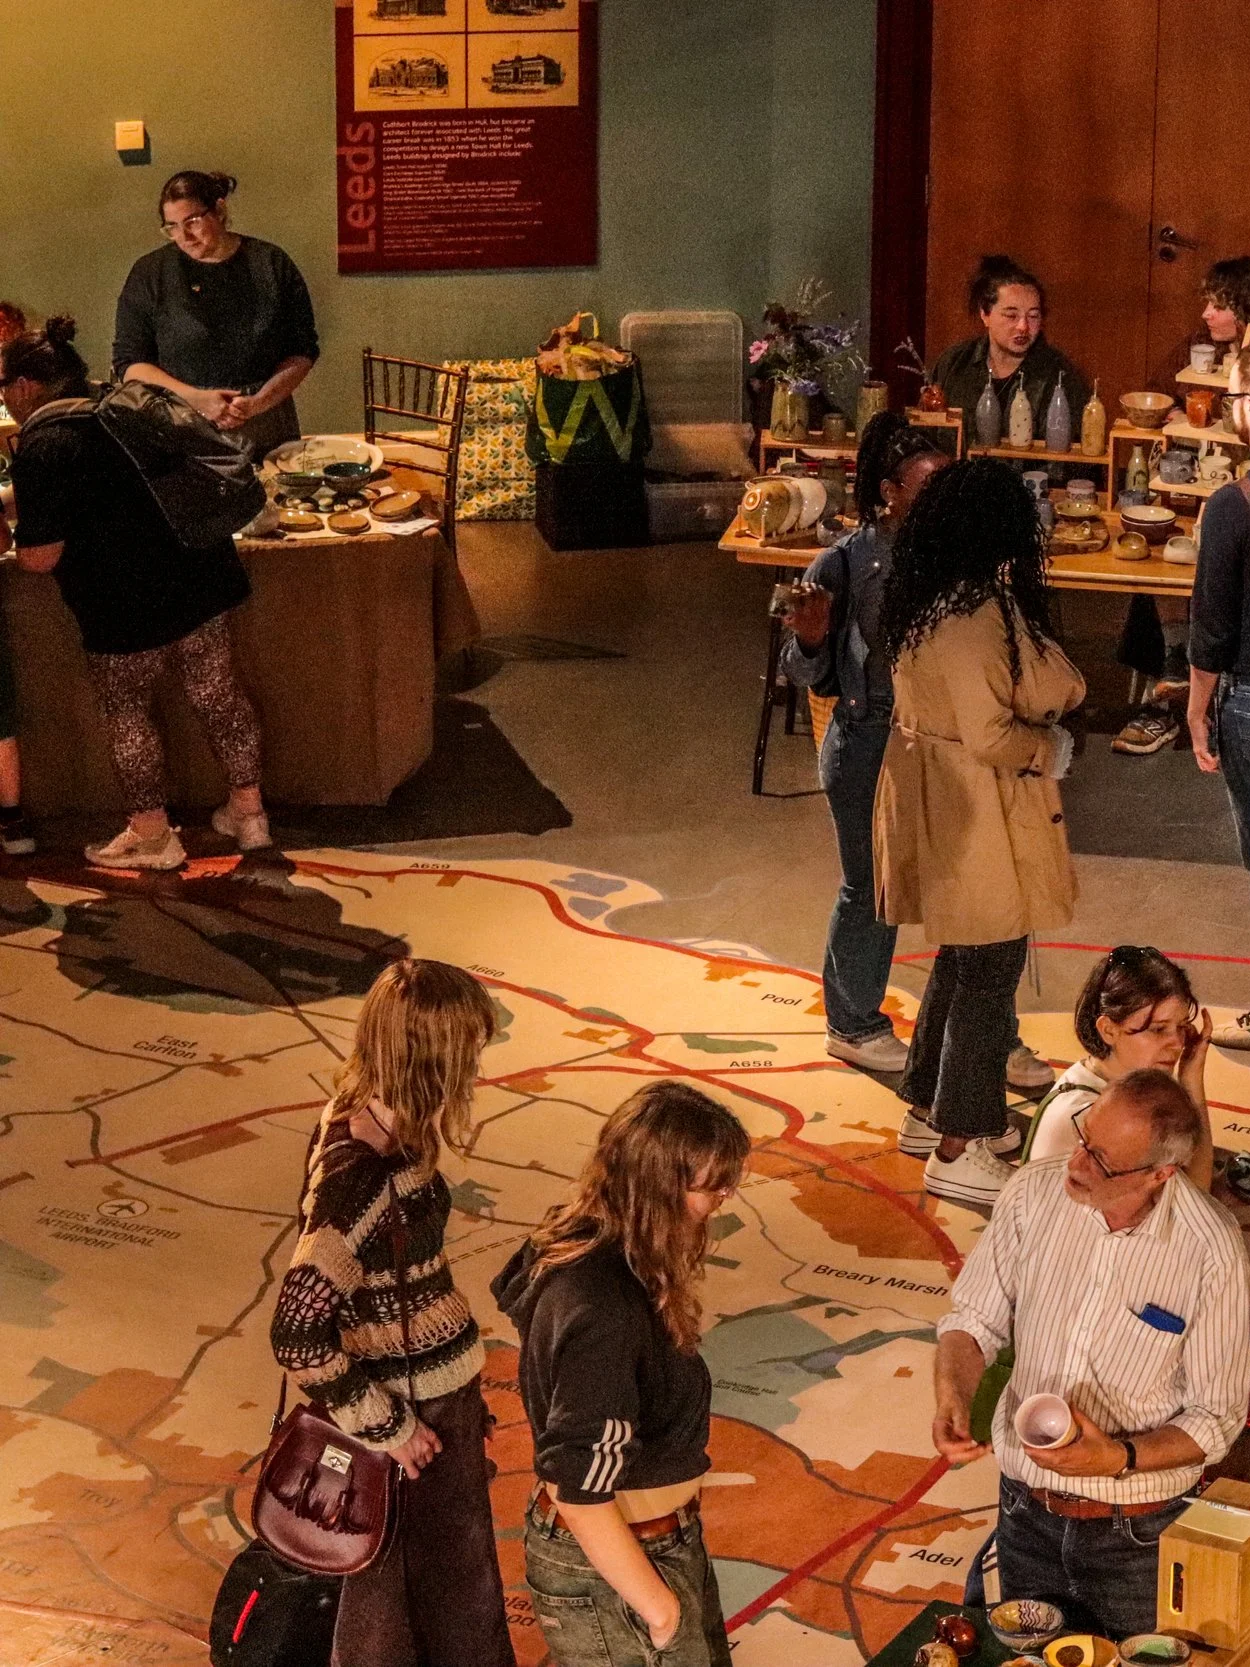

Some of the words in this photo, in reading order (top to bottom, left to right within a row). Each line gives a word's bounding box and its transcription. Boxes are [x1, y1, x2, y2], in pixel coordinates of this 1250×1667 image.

[337, 121, 376, 253] Leeds
[466, 964, 505, 977] A660
[760, 993, 803, 1006] Pool
[133, 1041, 197, 1059] Carlton
[157, 1035, 198, 1048] East
[36, 1217, 155, 1247] INTERNATIONAL
[95, 1217, 181, 1240] BRADFORD
[49, 1231, 120, 1250] AIRPORT
[813, 1264, 881, 1285] Breary
[884, 1277, 949, 1296] Marsh
[908, 1549, 964, 1567] Adel
